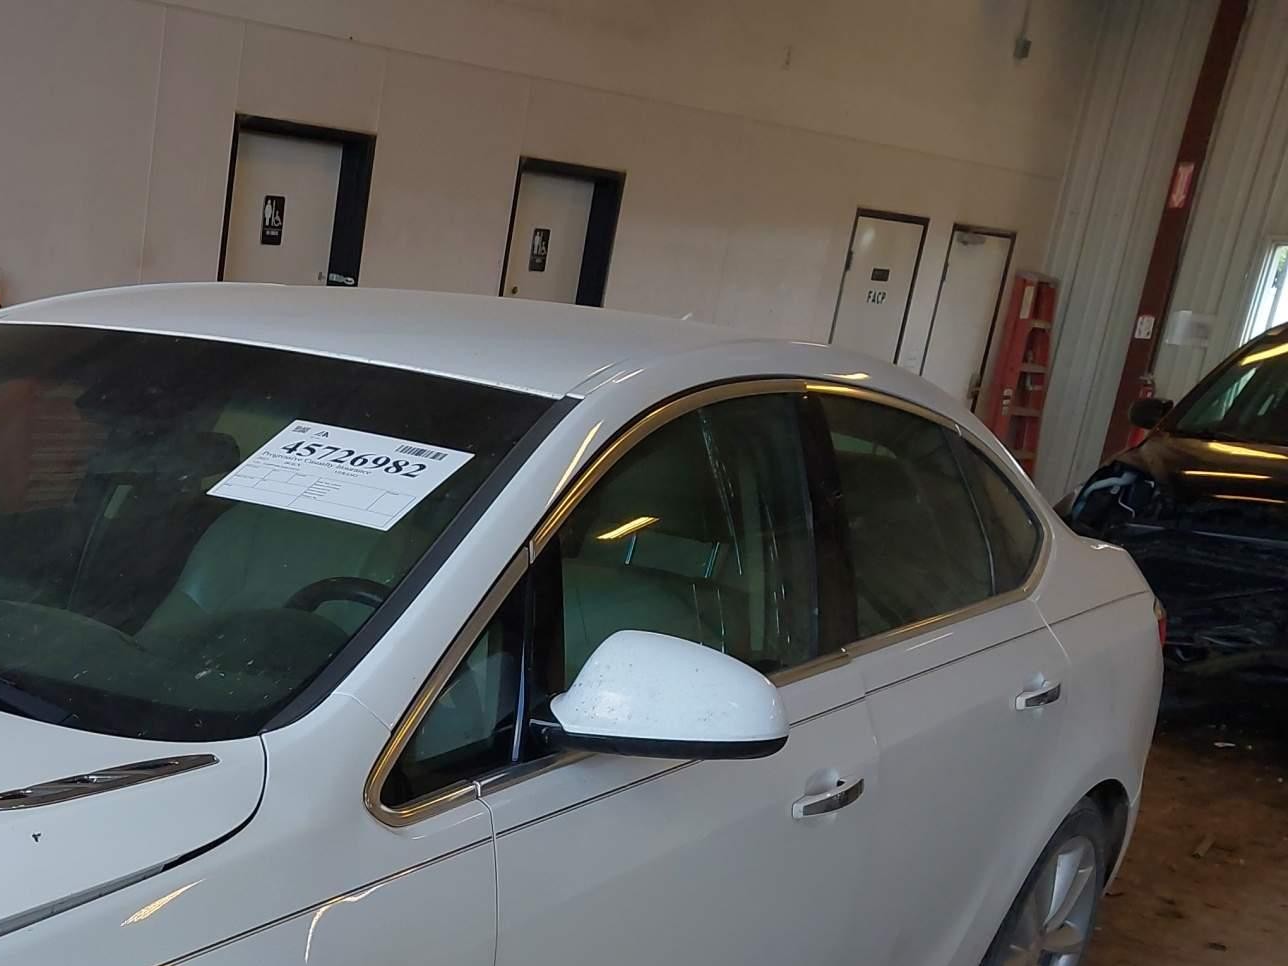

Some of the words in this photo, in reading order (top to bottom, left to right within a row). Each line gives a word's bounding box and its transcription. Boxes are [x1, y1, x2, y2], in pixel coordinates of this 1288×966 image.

[262, 451, 303, 462] Progressive
[336, 464, 372, 475] Insurance
[280, 440, 428, 478] 45726982
